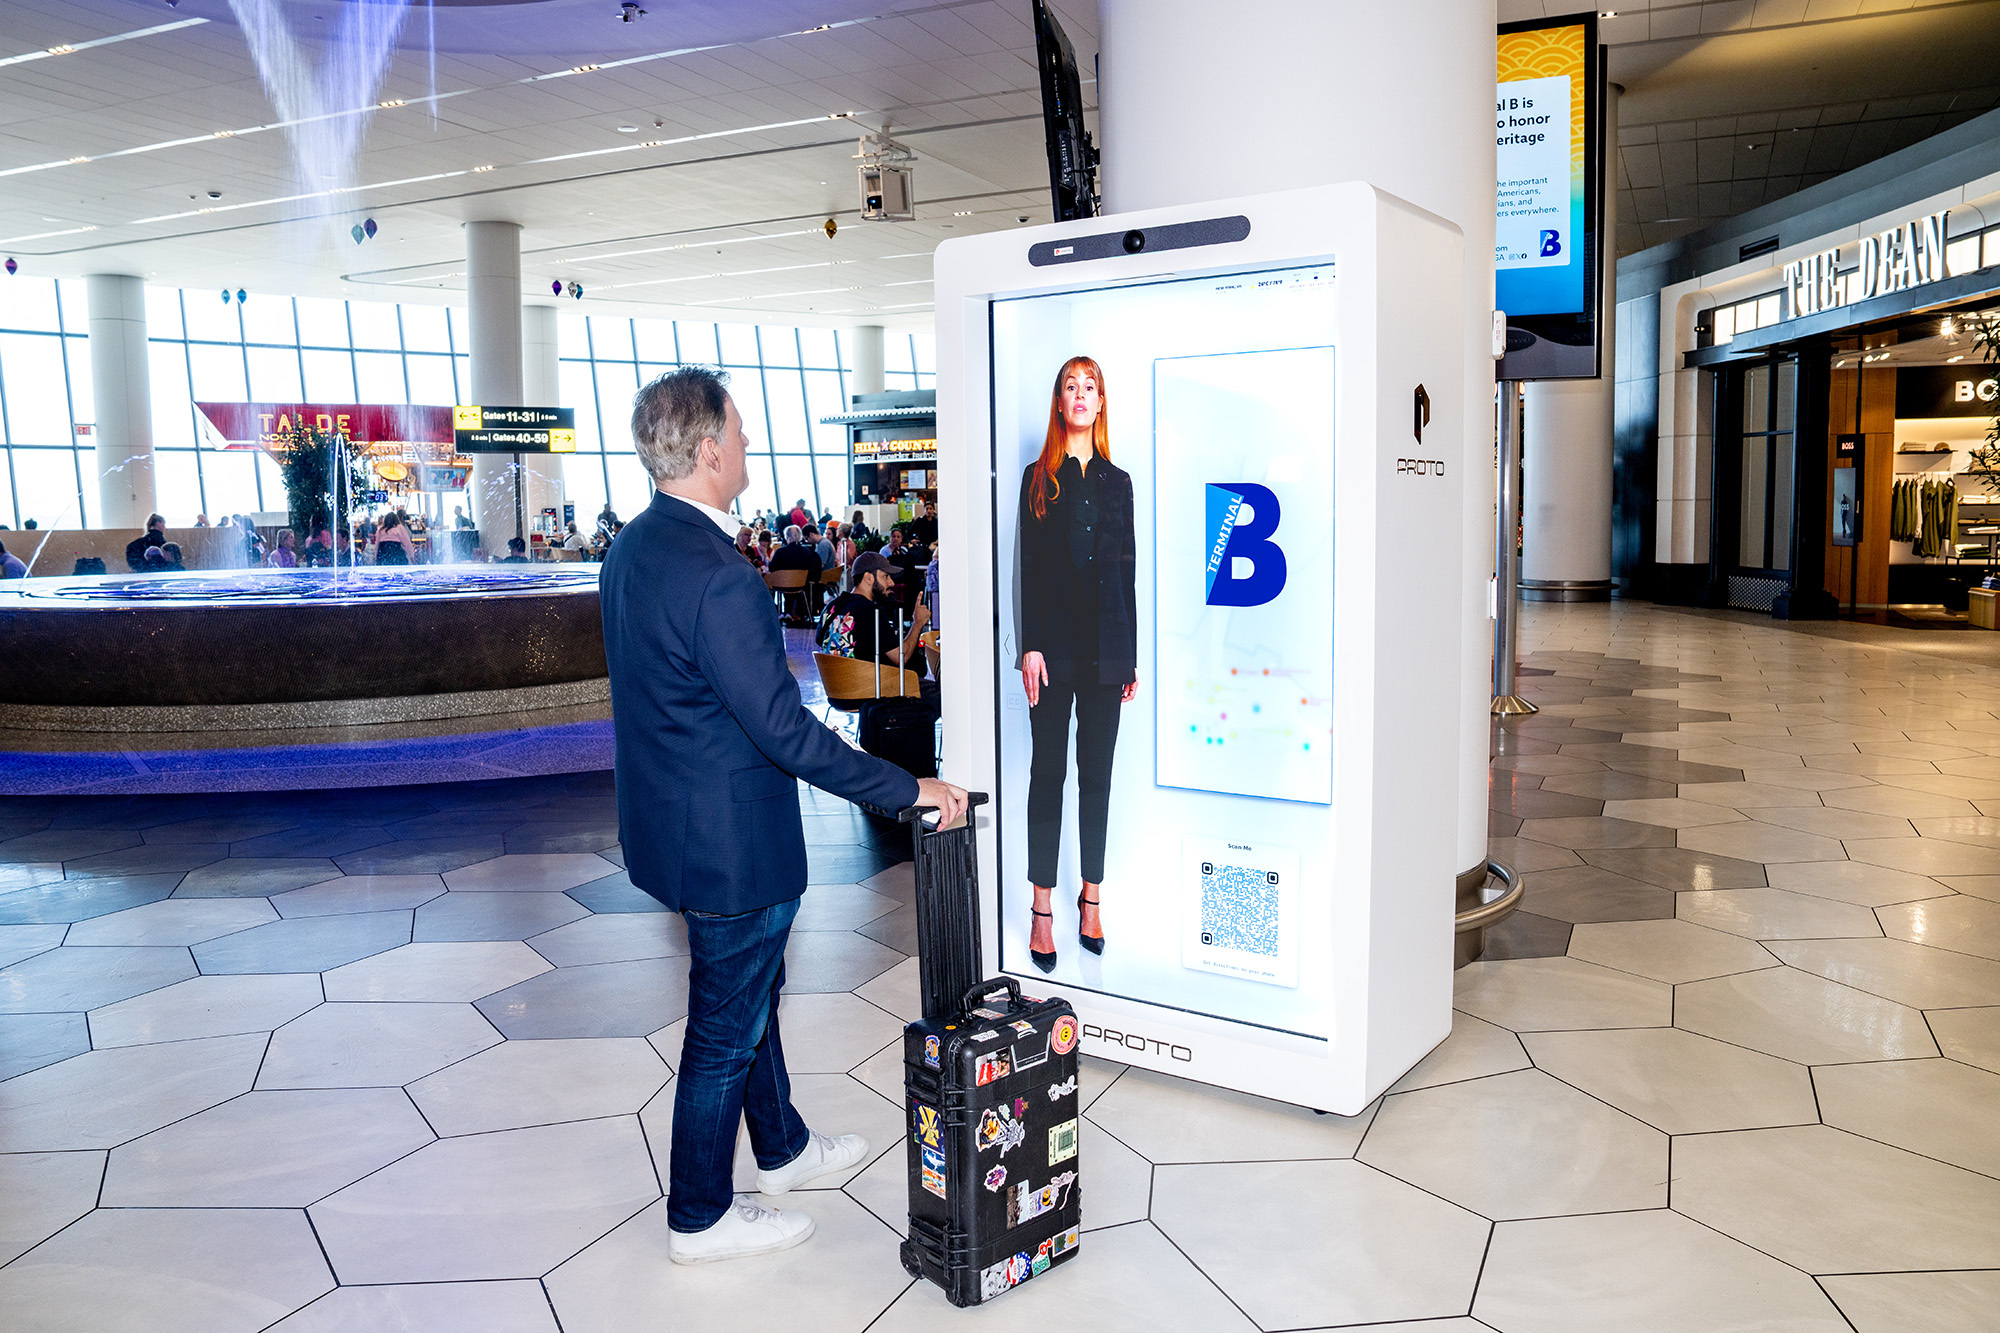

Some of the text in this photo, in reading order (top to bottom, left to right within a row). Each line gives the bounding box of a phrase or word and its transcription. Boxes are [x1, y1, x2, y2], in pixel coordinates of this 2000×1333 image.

[1510, 98, 1519, 110] B
[1522, 97, 1534, 109] is
[1509, 115, 1551, 127] honor
[1496, 133, 1545, 146] eritage
[1508, 177, 1548, 187] important
[1497, 188, 1541, 197] Americans,
[1518, 197, 1533, 206] and
[1510, 206, 1559, 216] everywhere.
[1783, 210, 1951, 320] THE DEAN
[482, 411, 506, 420] Gates
[506, 411, 535, 422] 11-31
[258, 413, 351, 434] TALDE
[492, 433, 516, 442] Gates
[516, 433, 549, 444] 40-59
[854, 441, 880, 454] HILL
[1841, 442, 1855, 450] BOSS
[1396, 458, 1445, 477] PROTO
[1205, 482, 1288, 607] TERMINAL B
[1082, 1023, 1192, 1062] PROTO
